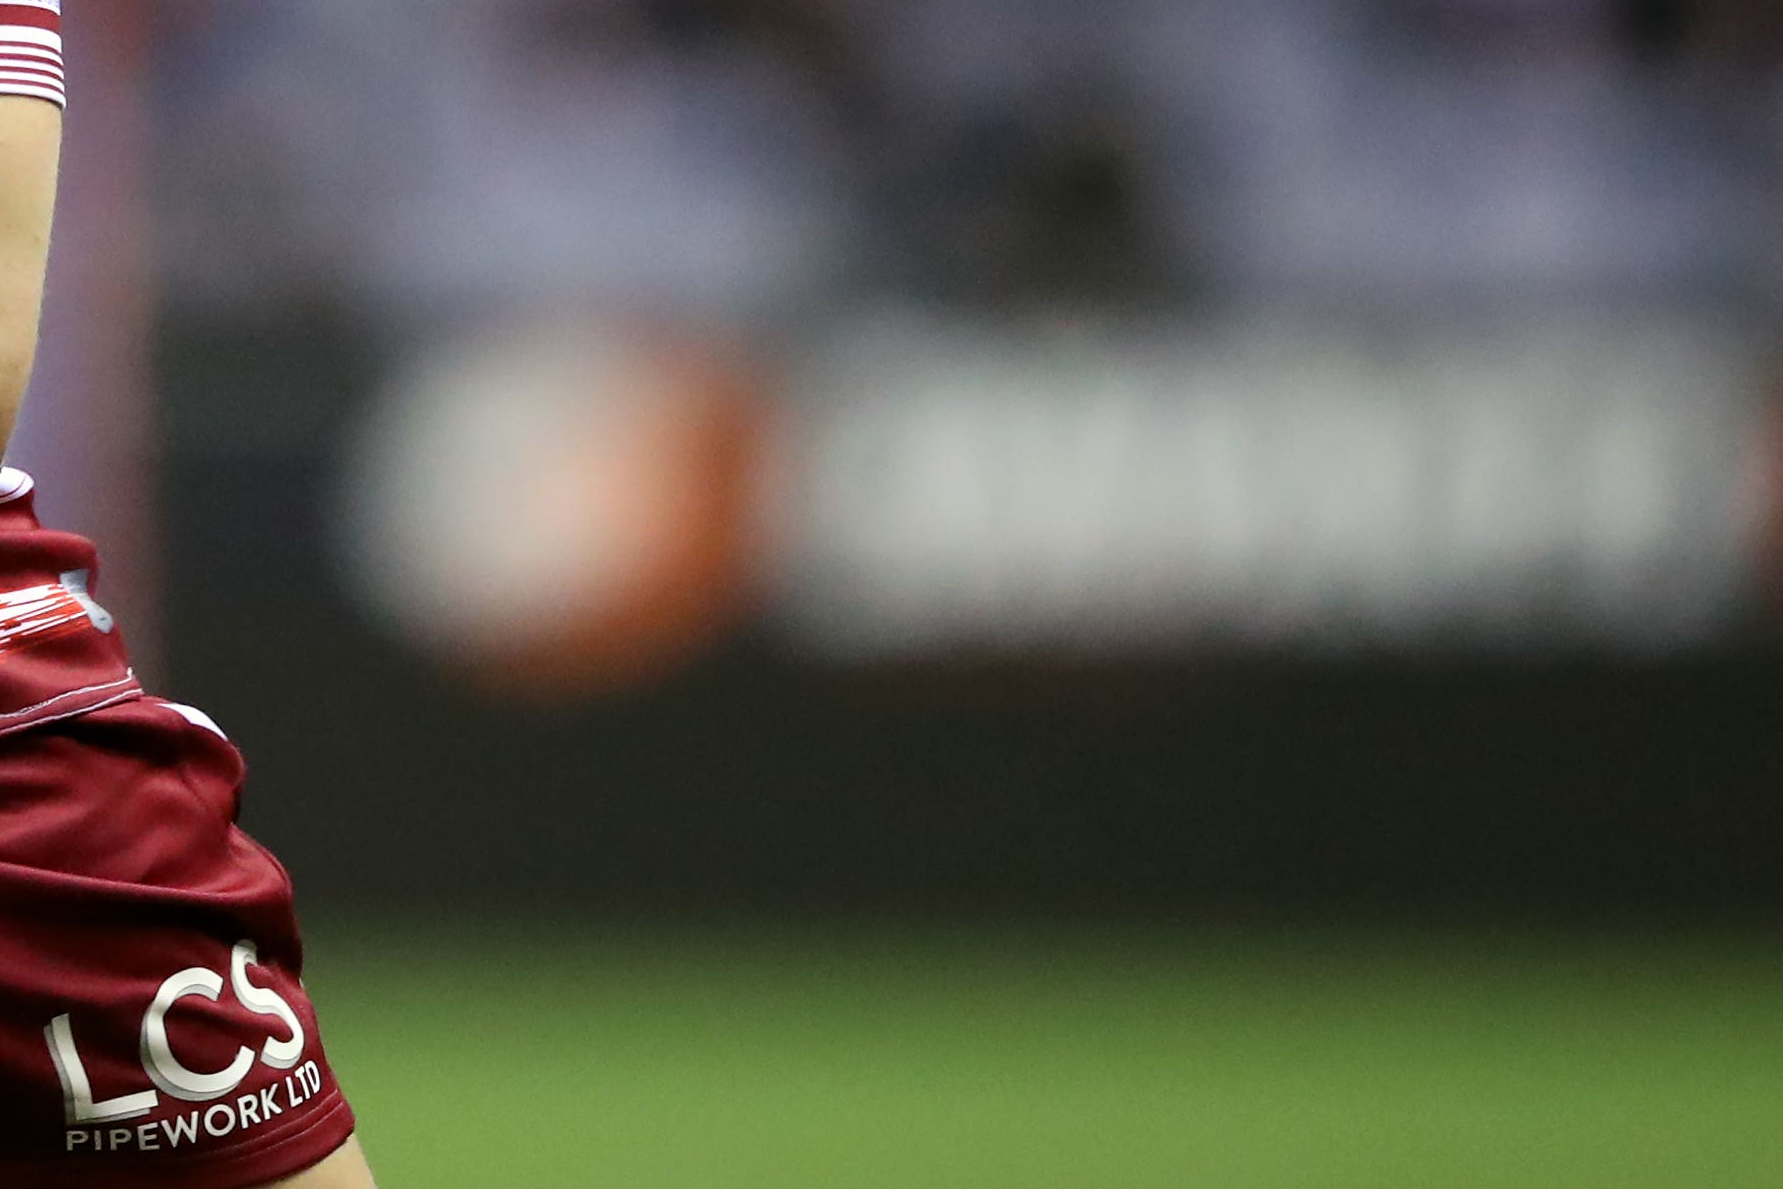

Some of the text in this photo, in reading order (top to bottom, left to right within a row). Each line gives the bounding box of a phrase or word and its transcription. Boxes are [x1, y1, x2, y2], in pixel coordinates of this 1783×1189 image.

[43, 939, 305, 1125] LCS
[66, 1060, 321, 1151] PIPEWORK LTD
